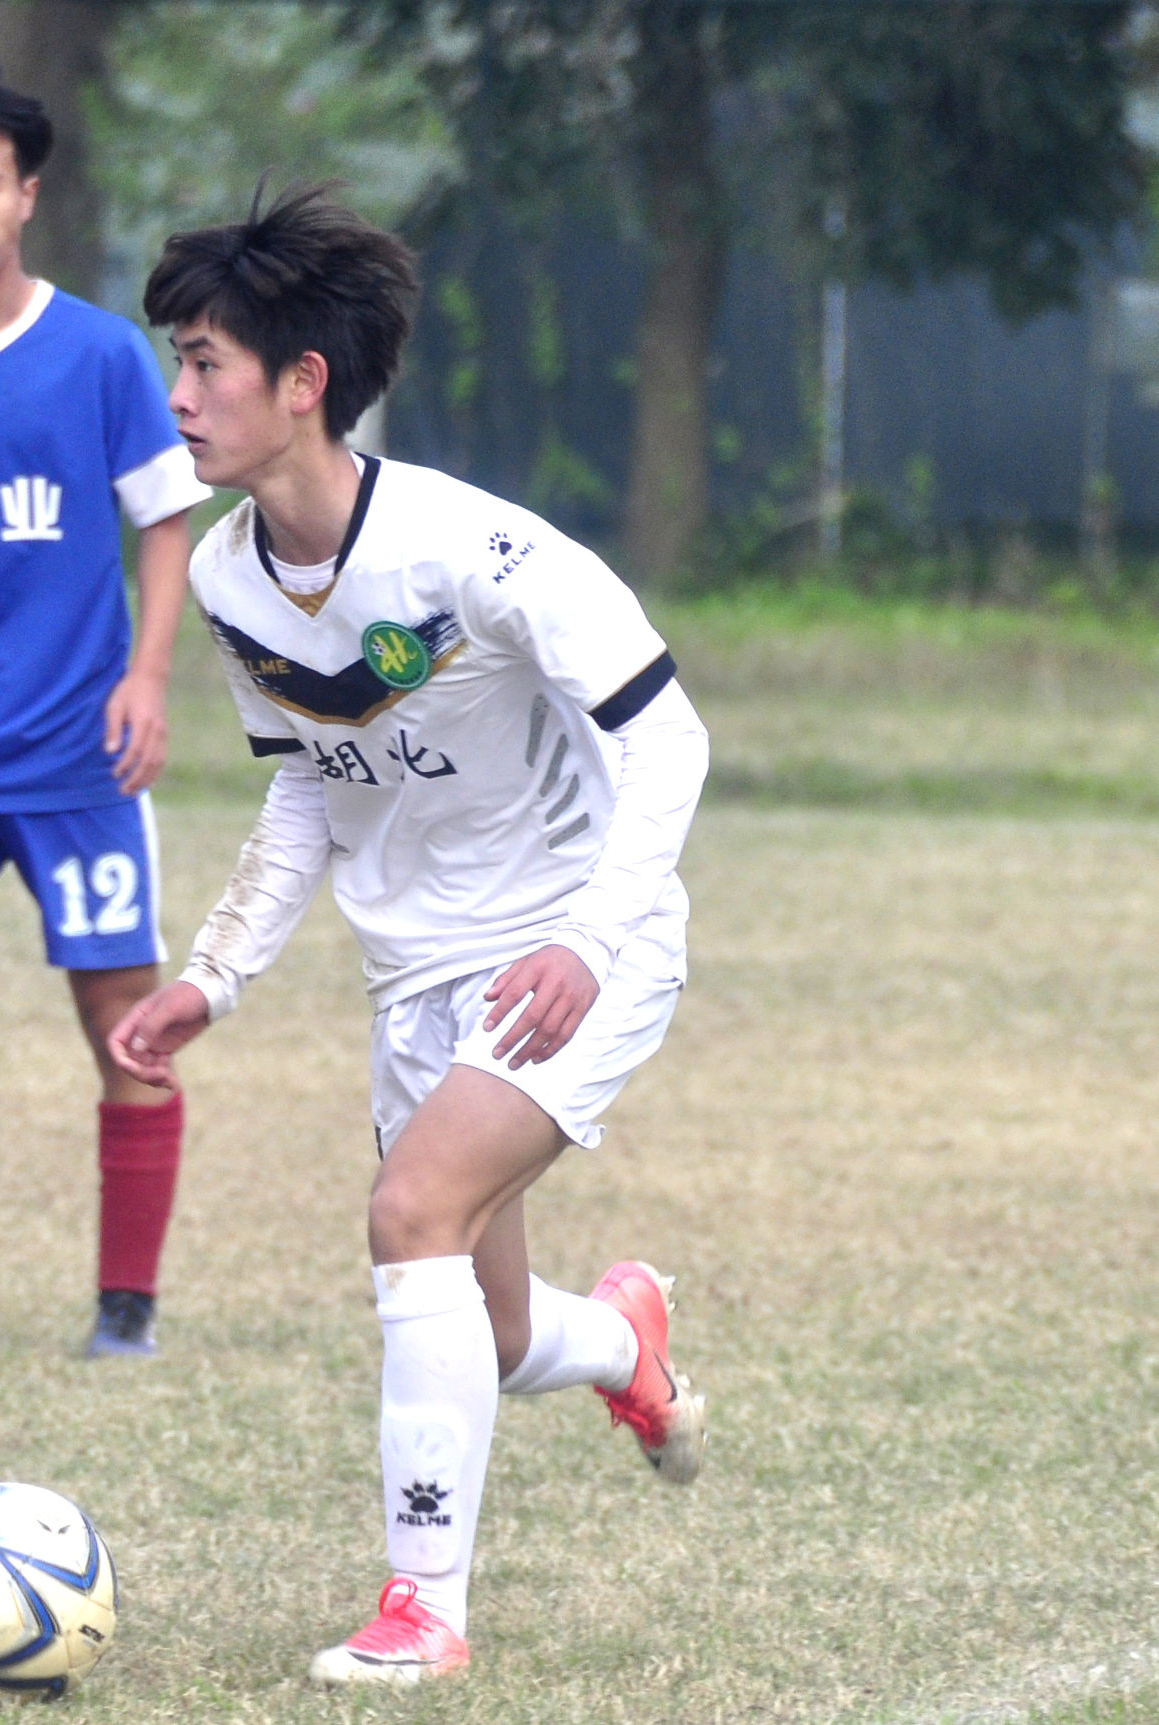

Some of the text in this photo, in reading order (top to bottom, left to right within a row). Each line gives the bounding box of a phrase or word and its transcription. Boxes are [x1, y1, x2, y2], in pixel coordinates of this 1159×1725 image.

[492, 540, 536, 584] KELME
[243, 658, 292, 676] LME
[52, 850, 142, 937] 12
[396, 1510, 452, 1527] KELME
